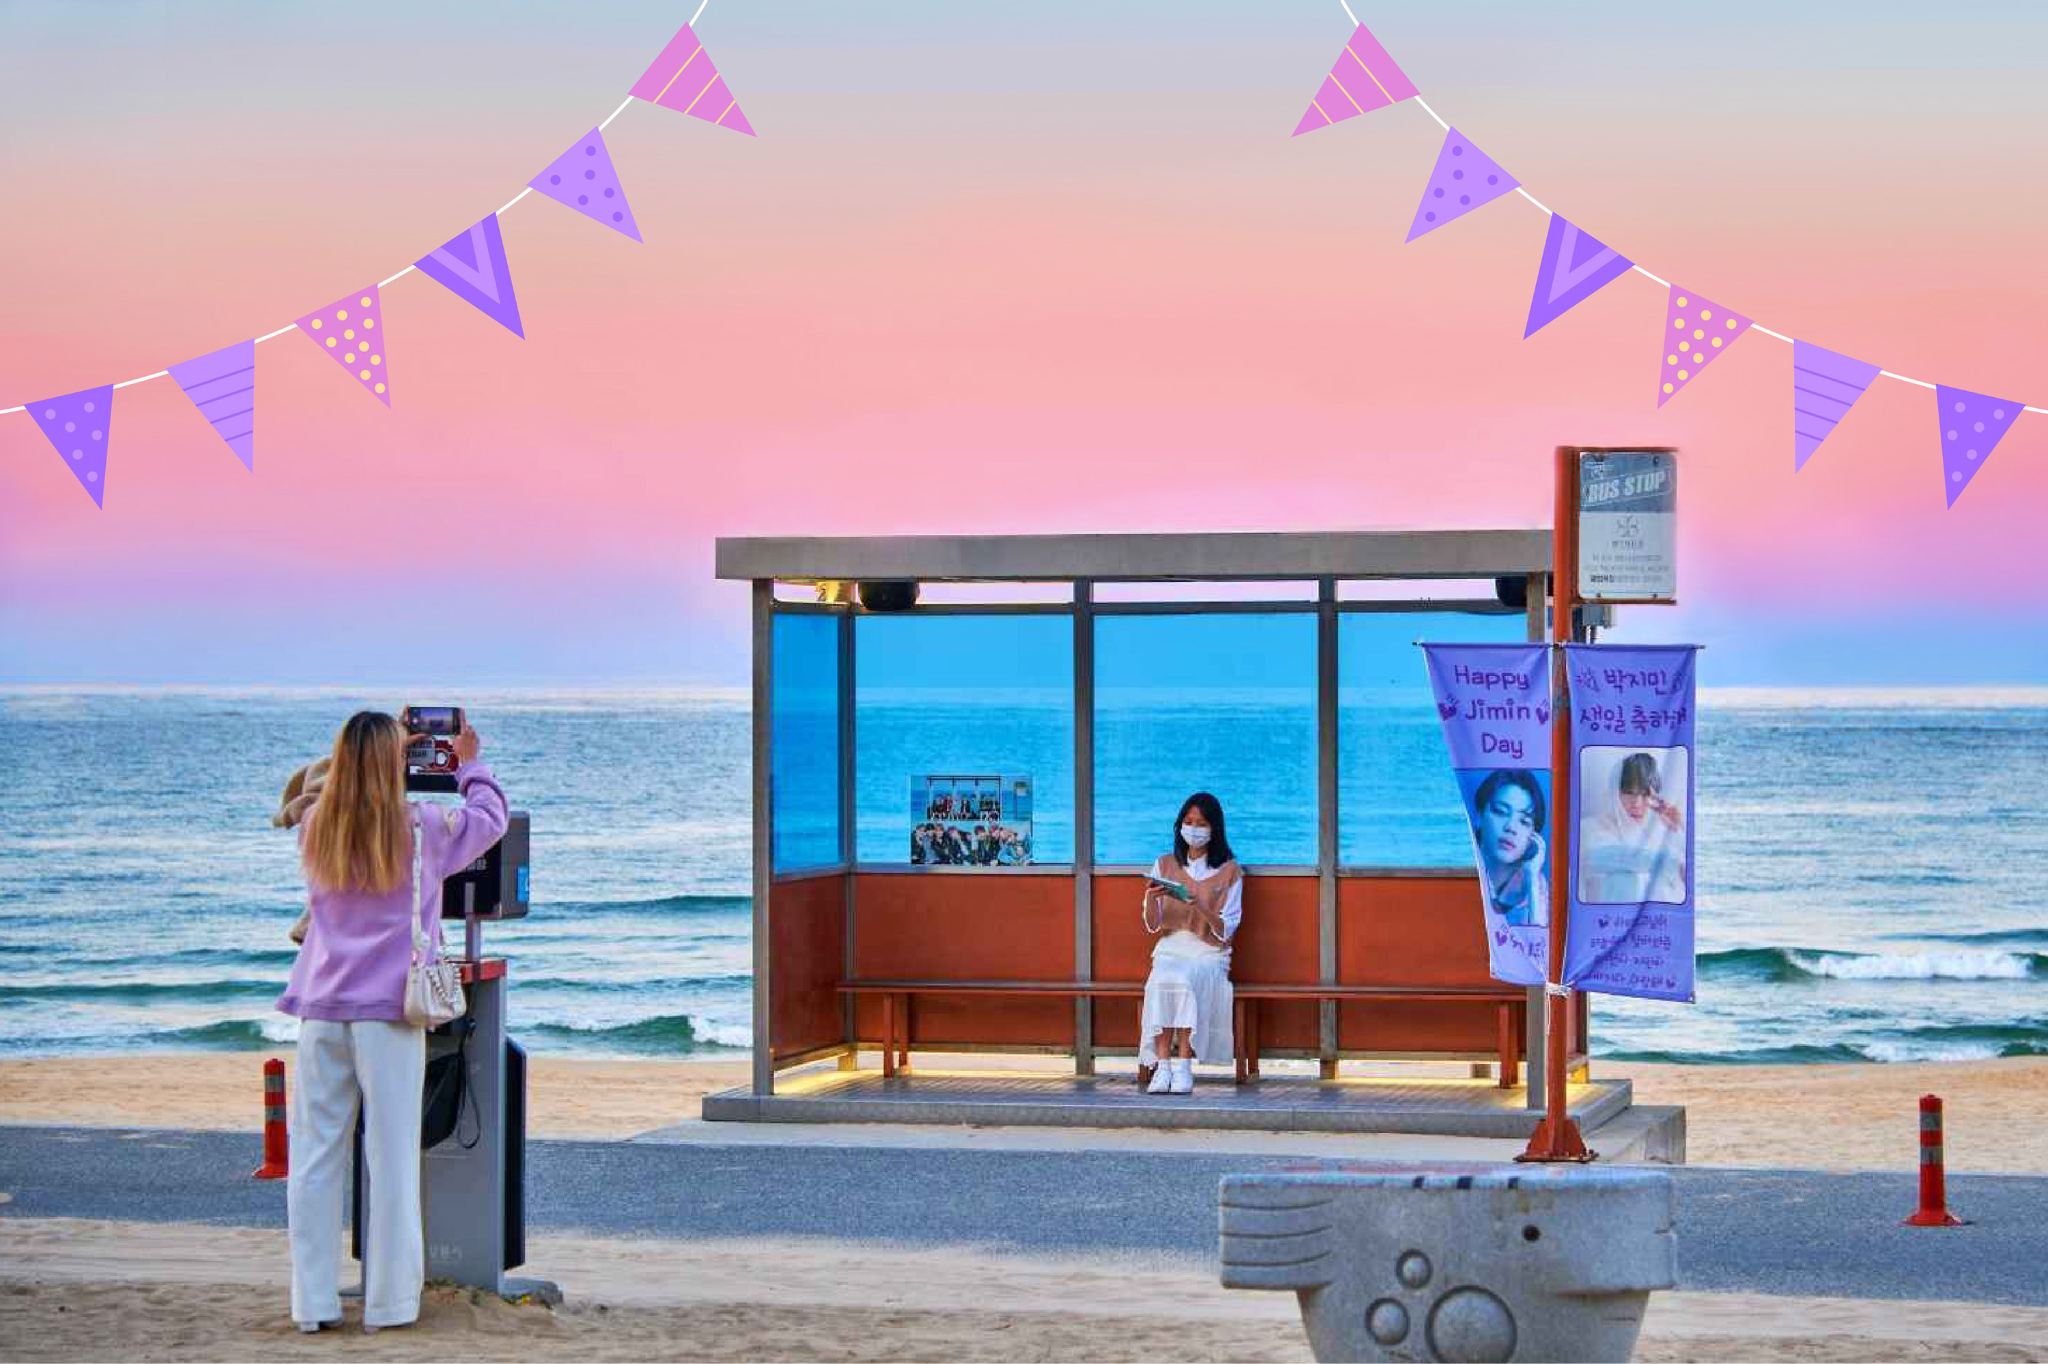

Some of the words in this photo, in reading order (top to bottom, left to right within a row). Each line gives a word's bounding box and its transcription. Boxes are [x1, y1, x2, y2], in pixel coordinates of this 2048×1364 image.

[1587, 479, 1619, 503] BUS
[1624, 471, 1664, 496] STOP
[1455, 664, 1530, 691] Happy
[1603, 668, 1671, 696] 박지민
[1465, 698, 1531, 721] Jimin
[1579, 704, 1626, 735] 생일
[1481, 731, 1524, 760] Day
